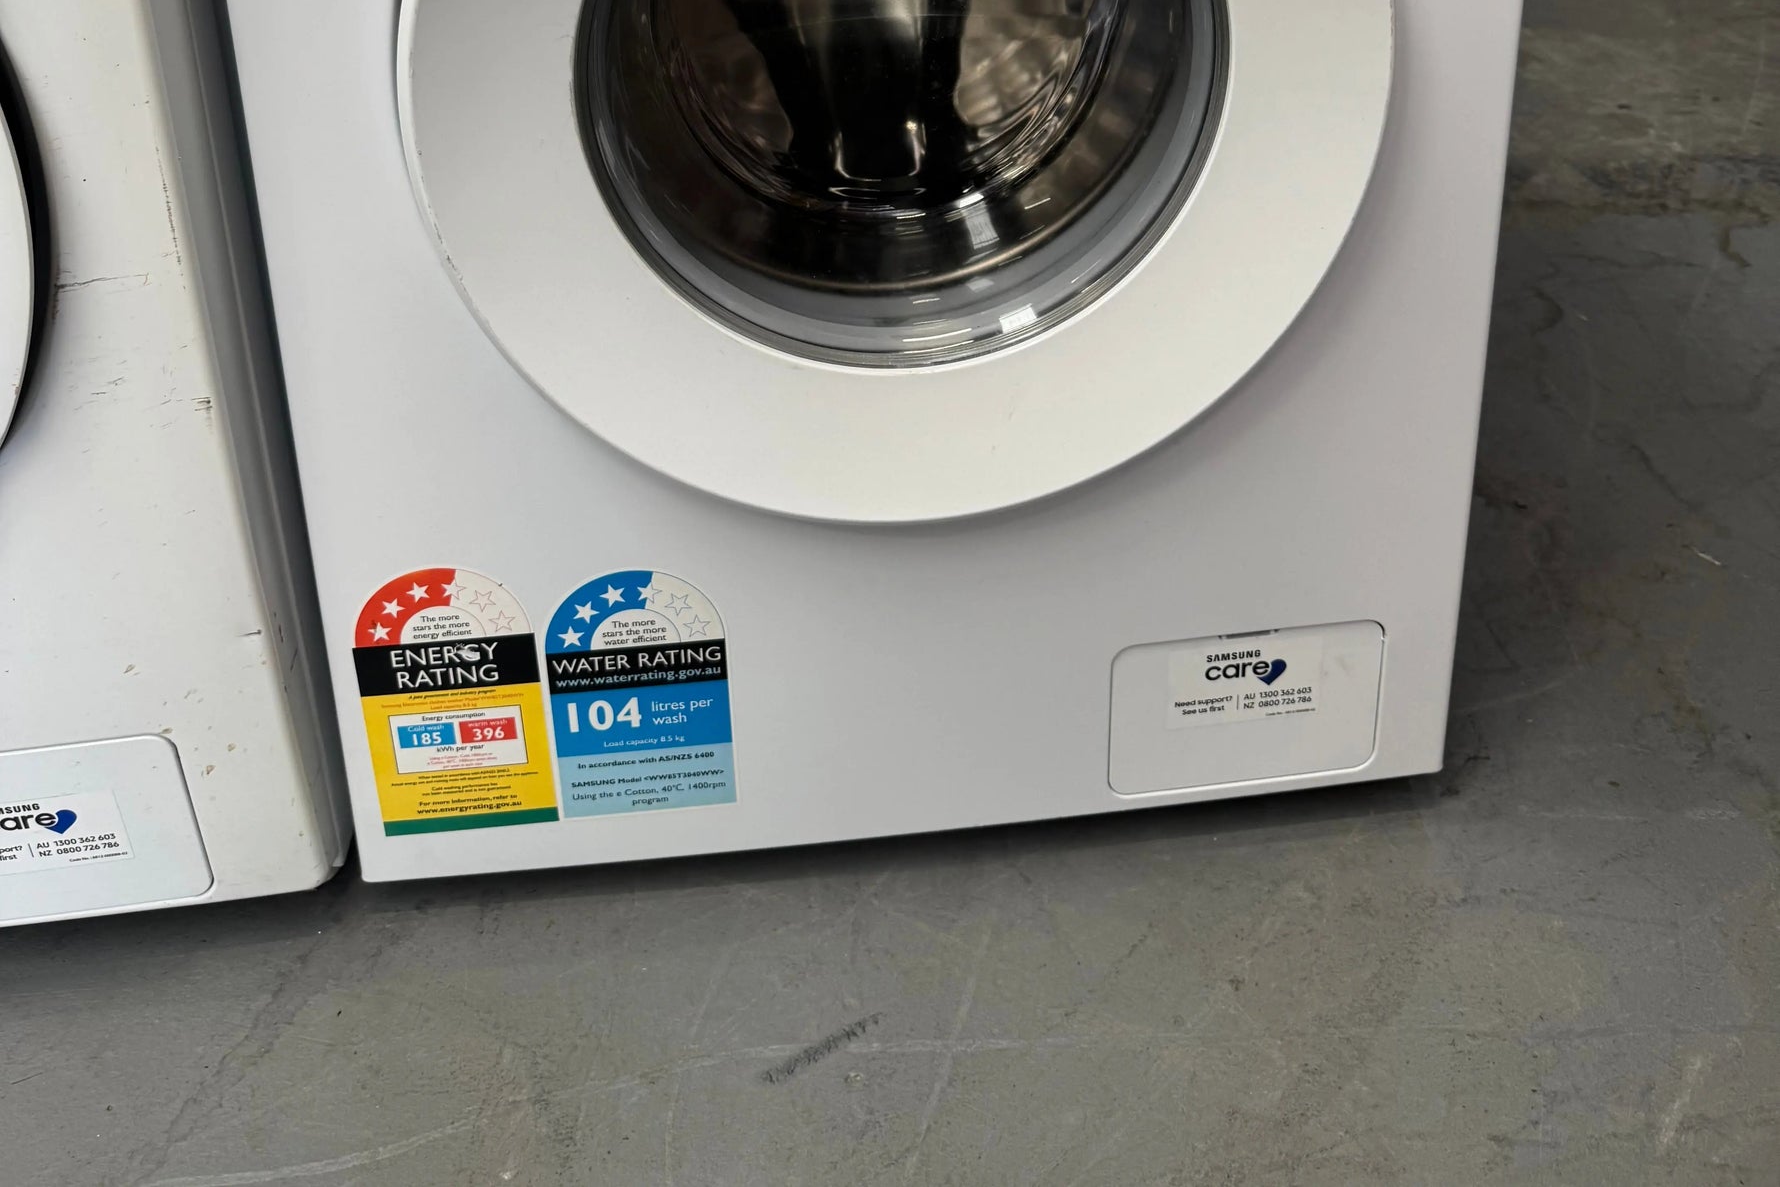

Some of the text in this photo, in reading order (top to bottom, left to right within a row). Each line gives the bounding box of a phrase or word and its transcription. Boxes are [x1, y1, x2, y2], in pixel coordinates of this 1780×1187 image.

[412, 624, 432, 632] stars
[434, 622, 447, 630] the
[612, 619, 656, 629] The more
[413, 629, 472, 640] energy efficient
[602, 626, 668, 638] stars the more
[604, 634, 668, 646] water efficient
[390, 642, 499, 668] ENERGY
[552, 646, 722, 675] WATER RATING
[1206, 649, 1262, 663] SAMSUNG
[396, 664, 500, 689] RATING
[556, 666, 722, 689] www.waterrating.gov.au
[1204, 660, 1270, 682] care
[1243, 686, 1312, 701] AU 1300 362 603
[651, 698, 714, 712] litres per
[1174, 696, 1233, 708] Need support?
[1243, 696, 1312, 710] NZ 0800 726 786
[422, 712, 486, 722] Energy consumption
[567, 696, 642, 734] 104
[652, 712, 687, 726] wash
[1182, 708, 1197, 716] See
[490, 718, 508, 726] wash
[412, 732, 442, 746] 185
[472, 726, 505, 742] 396
[603, 740, 624, 748] Load
[626, 736, 658, 747] capacity
[674, 734, 685, 742] kg
[578, 762, 586, 770] In
[588, 759, 636, 769] accordance
[638, 756, 658, 764] with
[658, 754, 693, 763] AS/NZS
[571, 778, 616, 788] SAMSUNG
[618, 776, 642, 784] Model
[572, 791, 598, 802] Using
[600, 790, 614, 798] the
[624, 787, 659, 796] Cotton,
[688, 780, 726, 791] 1400rpm
[416, 800, 522, 814] www.energyrating.gov.au
[451, 796, 492, 804] information,
[632, 794, 669, 806] program
[36, 832, 116, 850] AU 1300 362 603
[38, 841, 120, 858] NZ 0800 726 786
